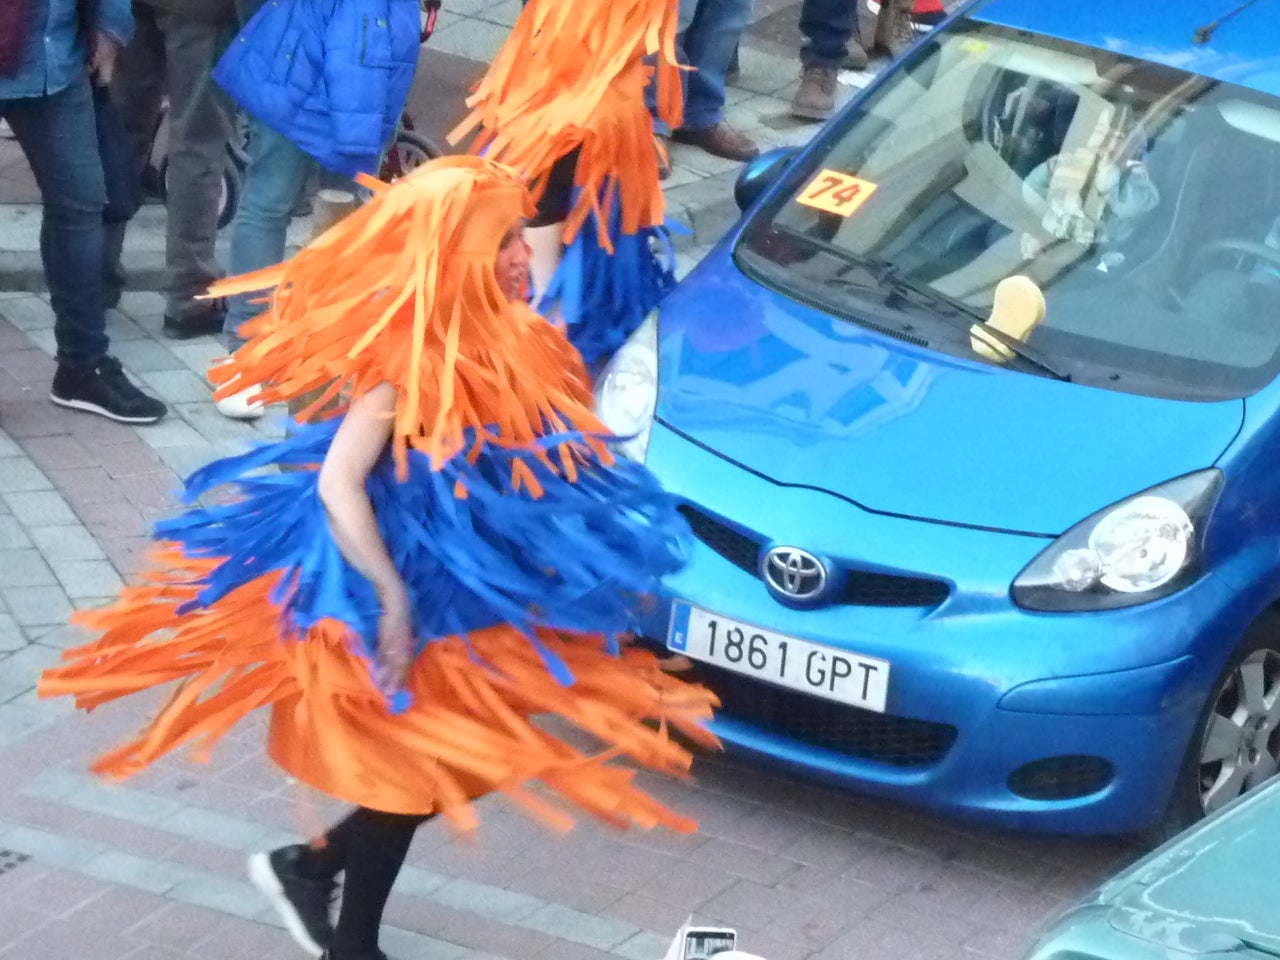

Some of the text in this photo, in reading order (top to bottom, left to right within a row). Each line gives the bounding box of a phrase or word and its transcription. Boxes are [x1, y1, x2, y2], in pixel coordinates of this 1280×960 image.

[807, 176, 861, 207] 74
[708, 620, 878, 701] 1861 GPT
